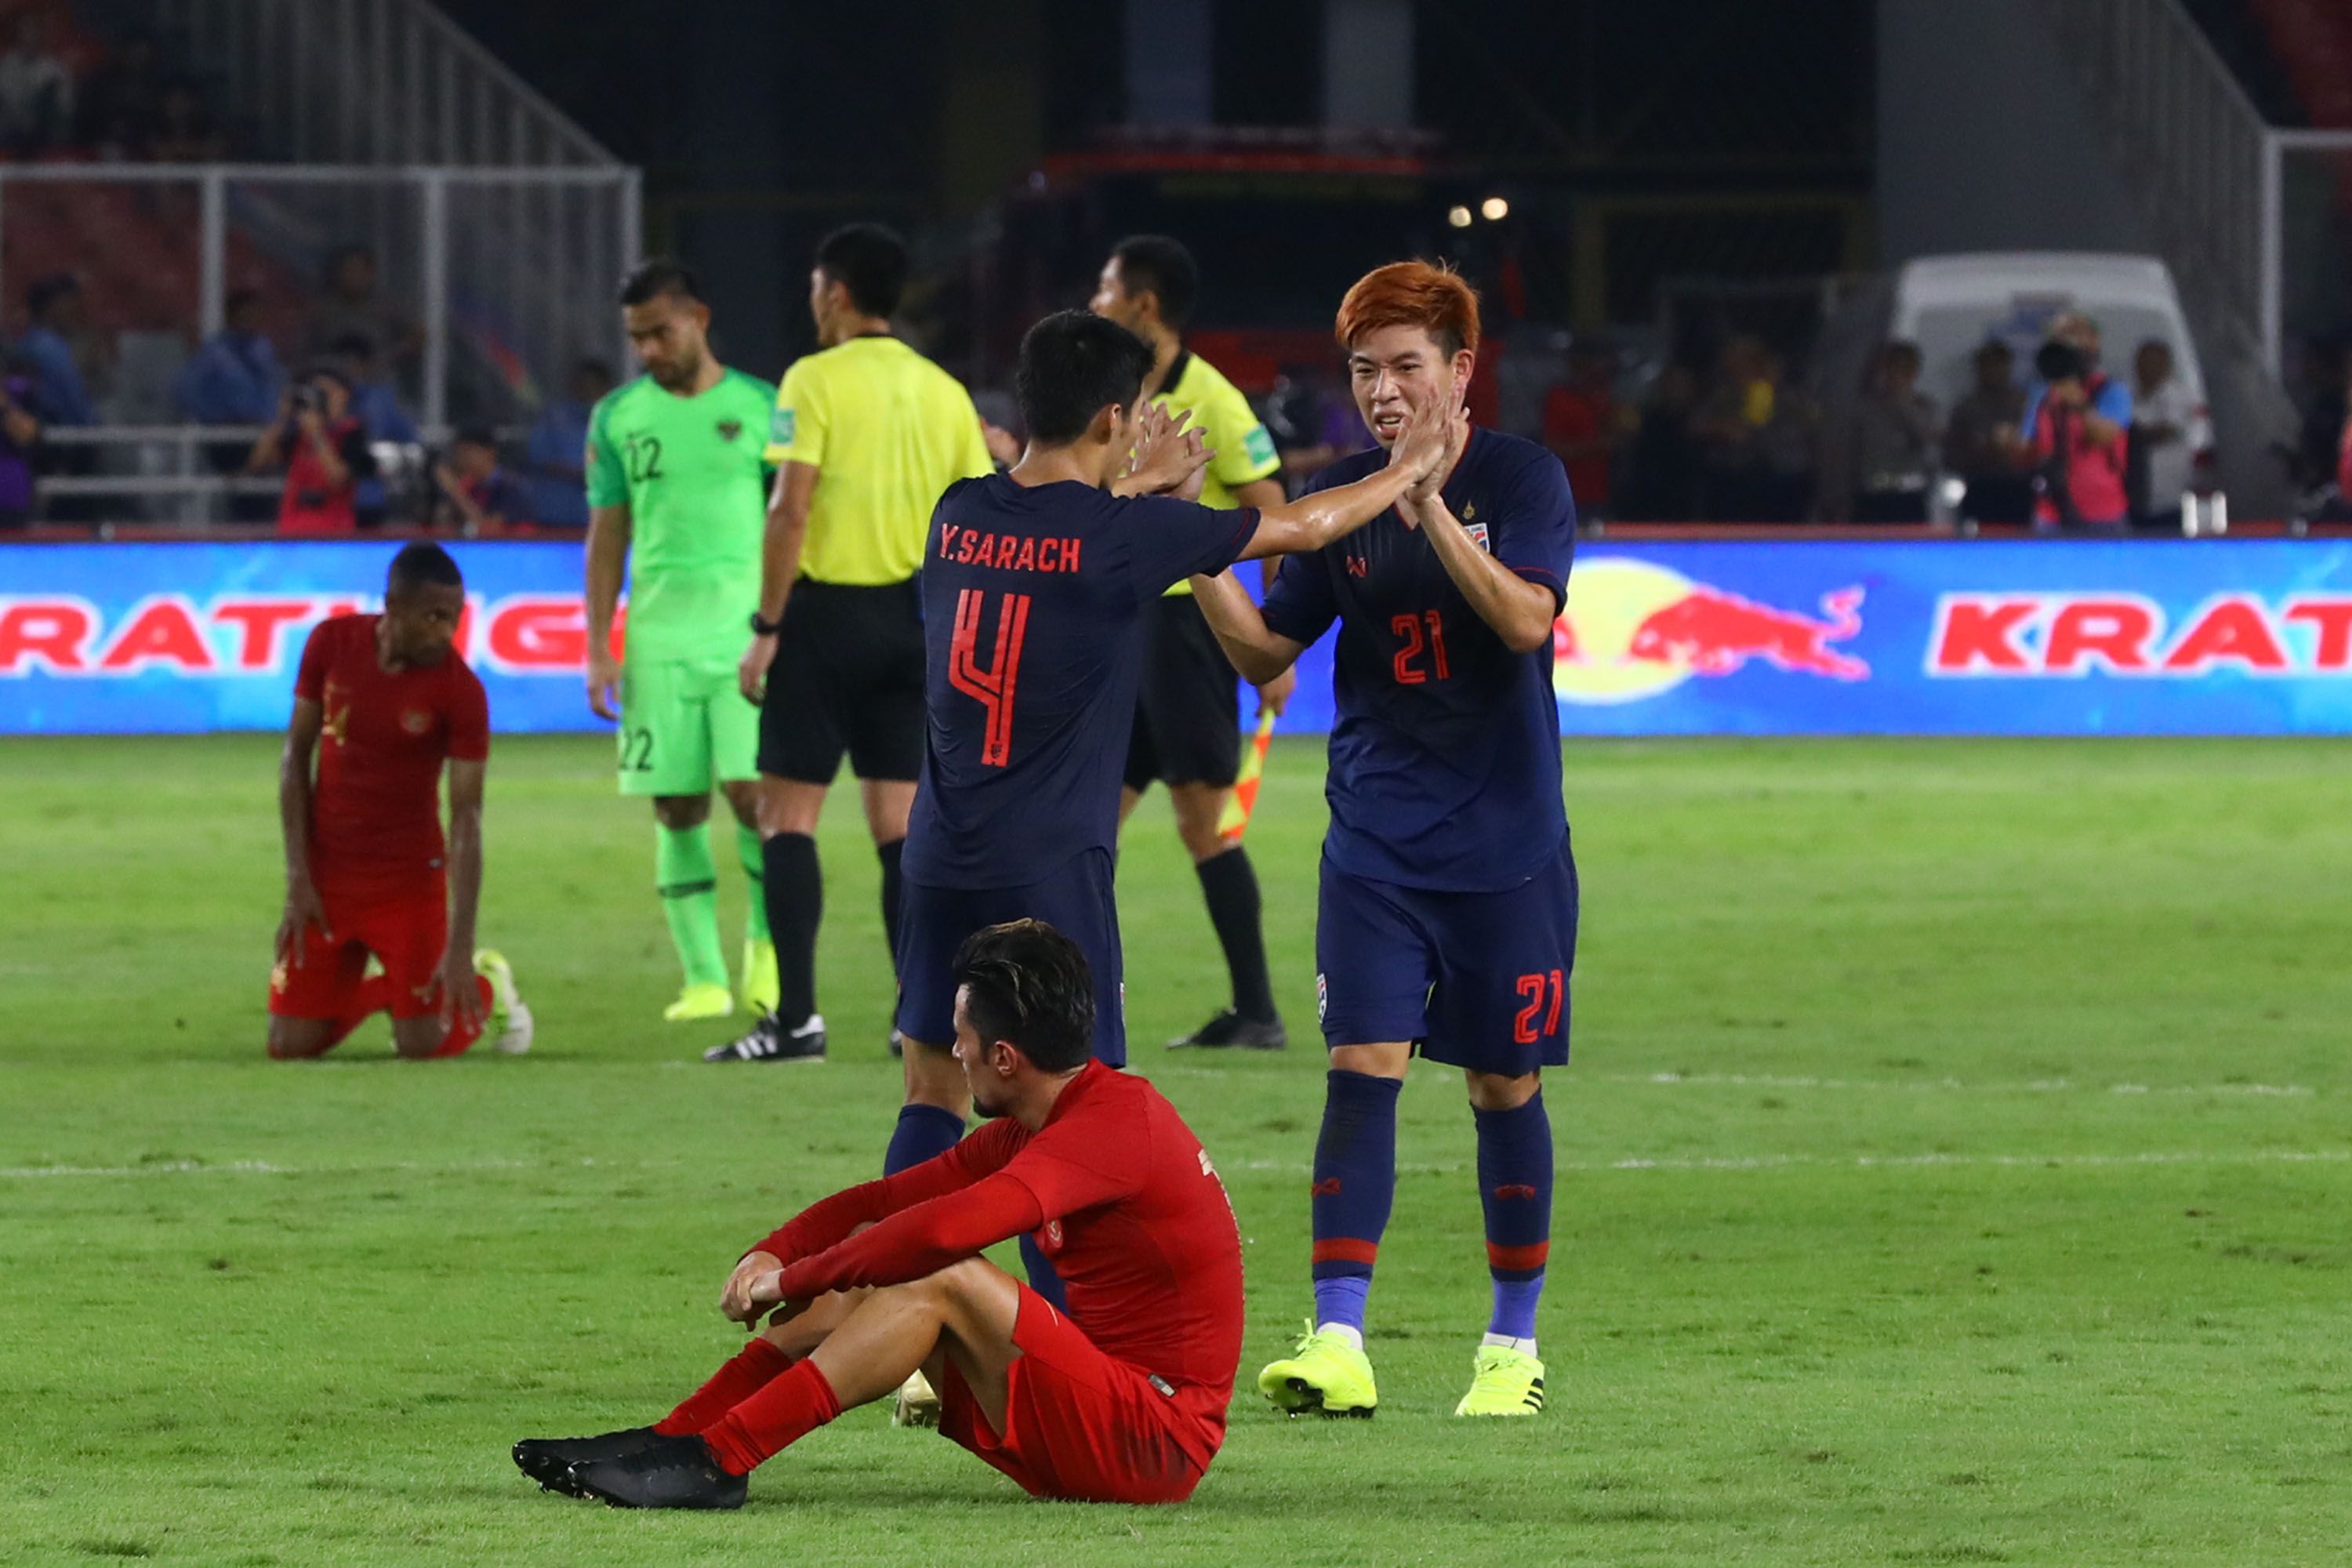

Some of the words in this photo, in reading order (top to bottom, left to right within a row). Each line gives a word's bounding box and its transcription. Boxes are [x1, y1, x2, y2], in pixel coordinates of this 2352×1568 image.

[940, 523, 1082, 573] Y.SARACH
[948, 589, 1031, 768] 4
[1391, 608, 1450, 684] 21
[1514, 969, 1563, 1044] 21
